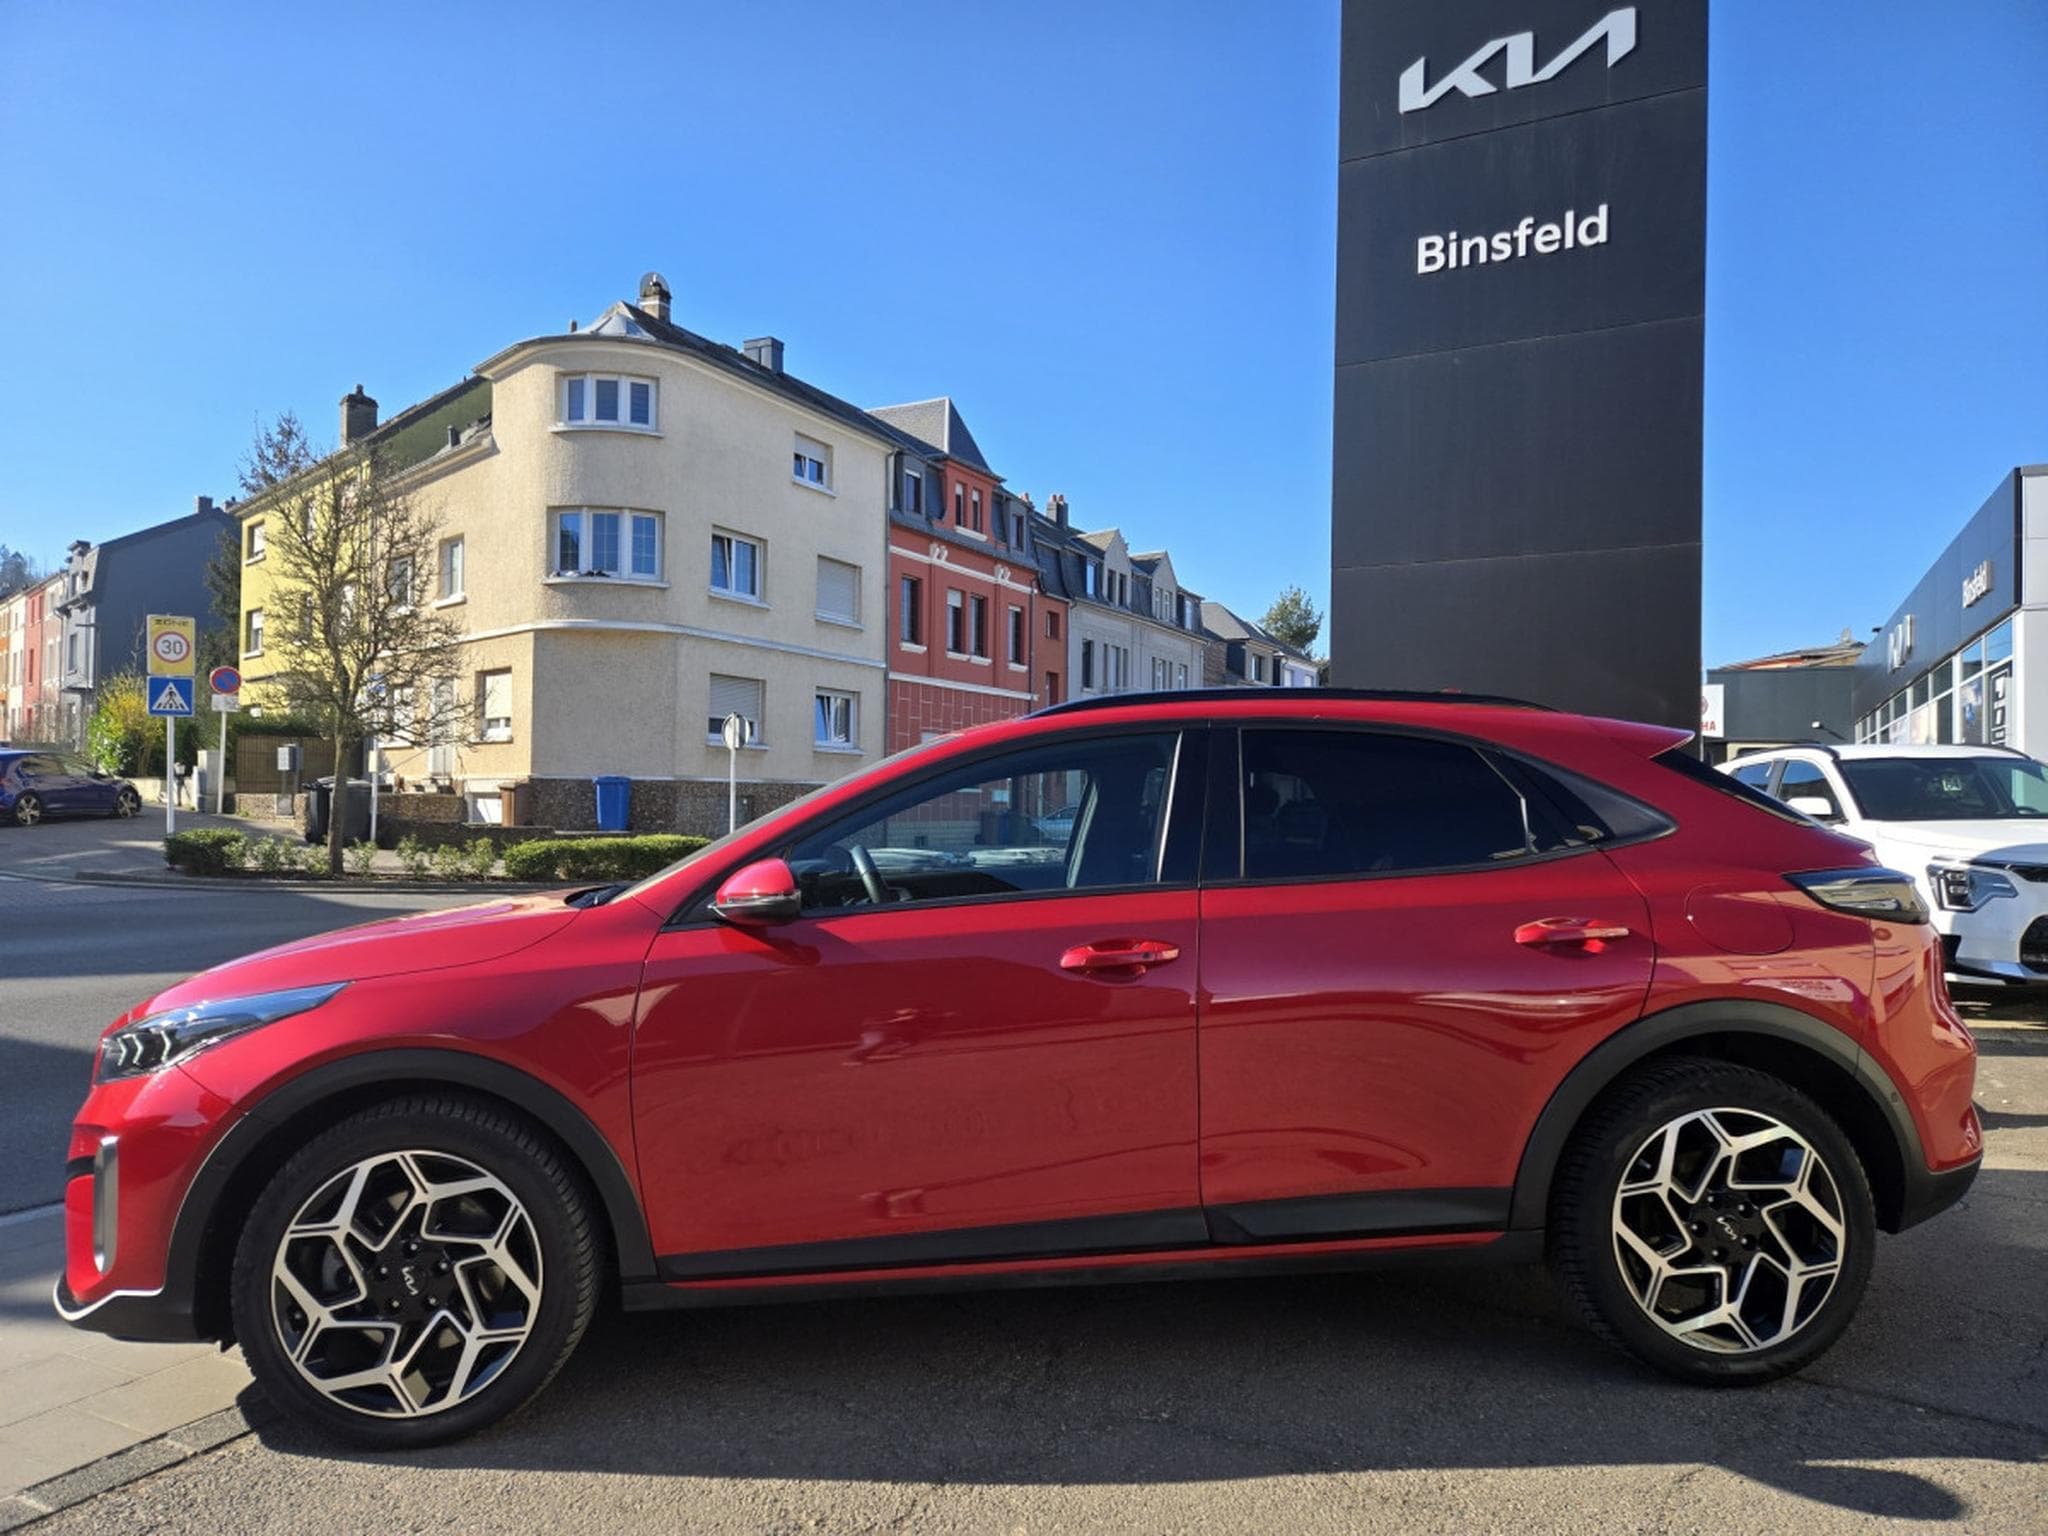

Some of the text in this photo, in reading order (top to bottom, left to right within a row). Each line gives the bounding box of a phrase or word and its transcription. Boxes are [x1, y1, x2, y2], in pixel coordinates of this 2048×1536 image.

[1399, 6, 1636, 114] KIA
[1417, 203, 1608, 274] Binsfeld
[161, 639, 183, 655] 30
